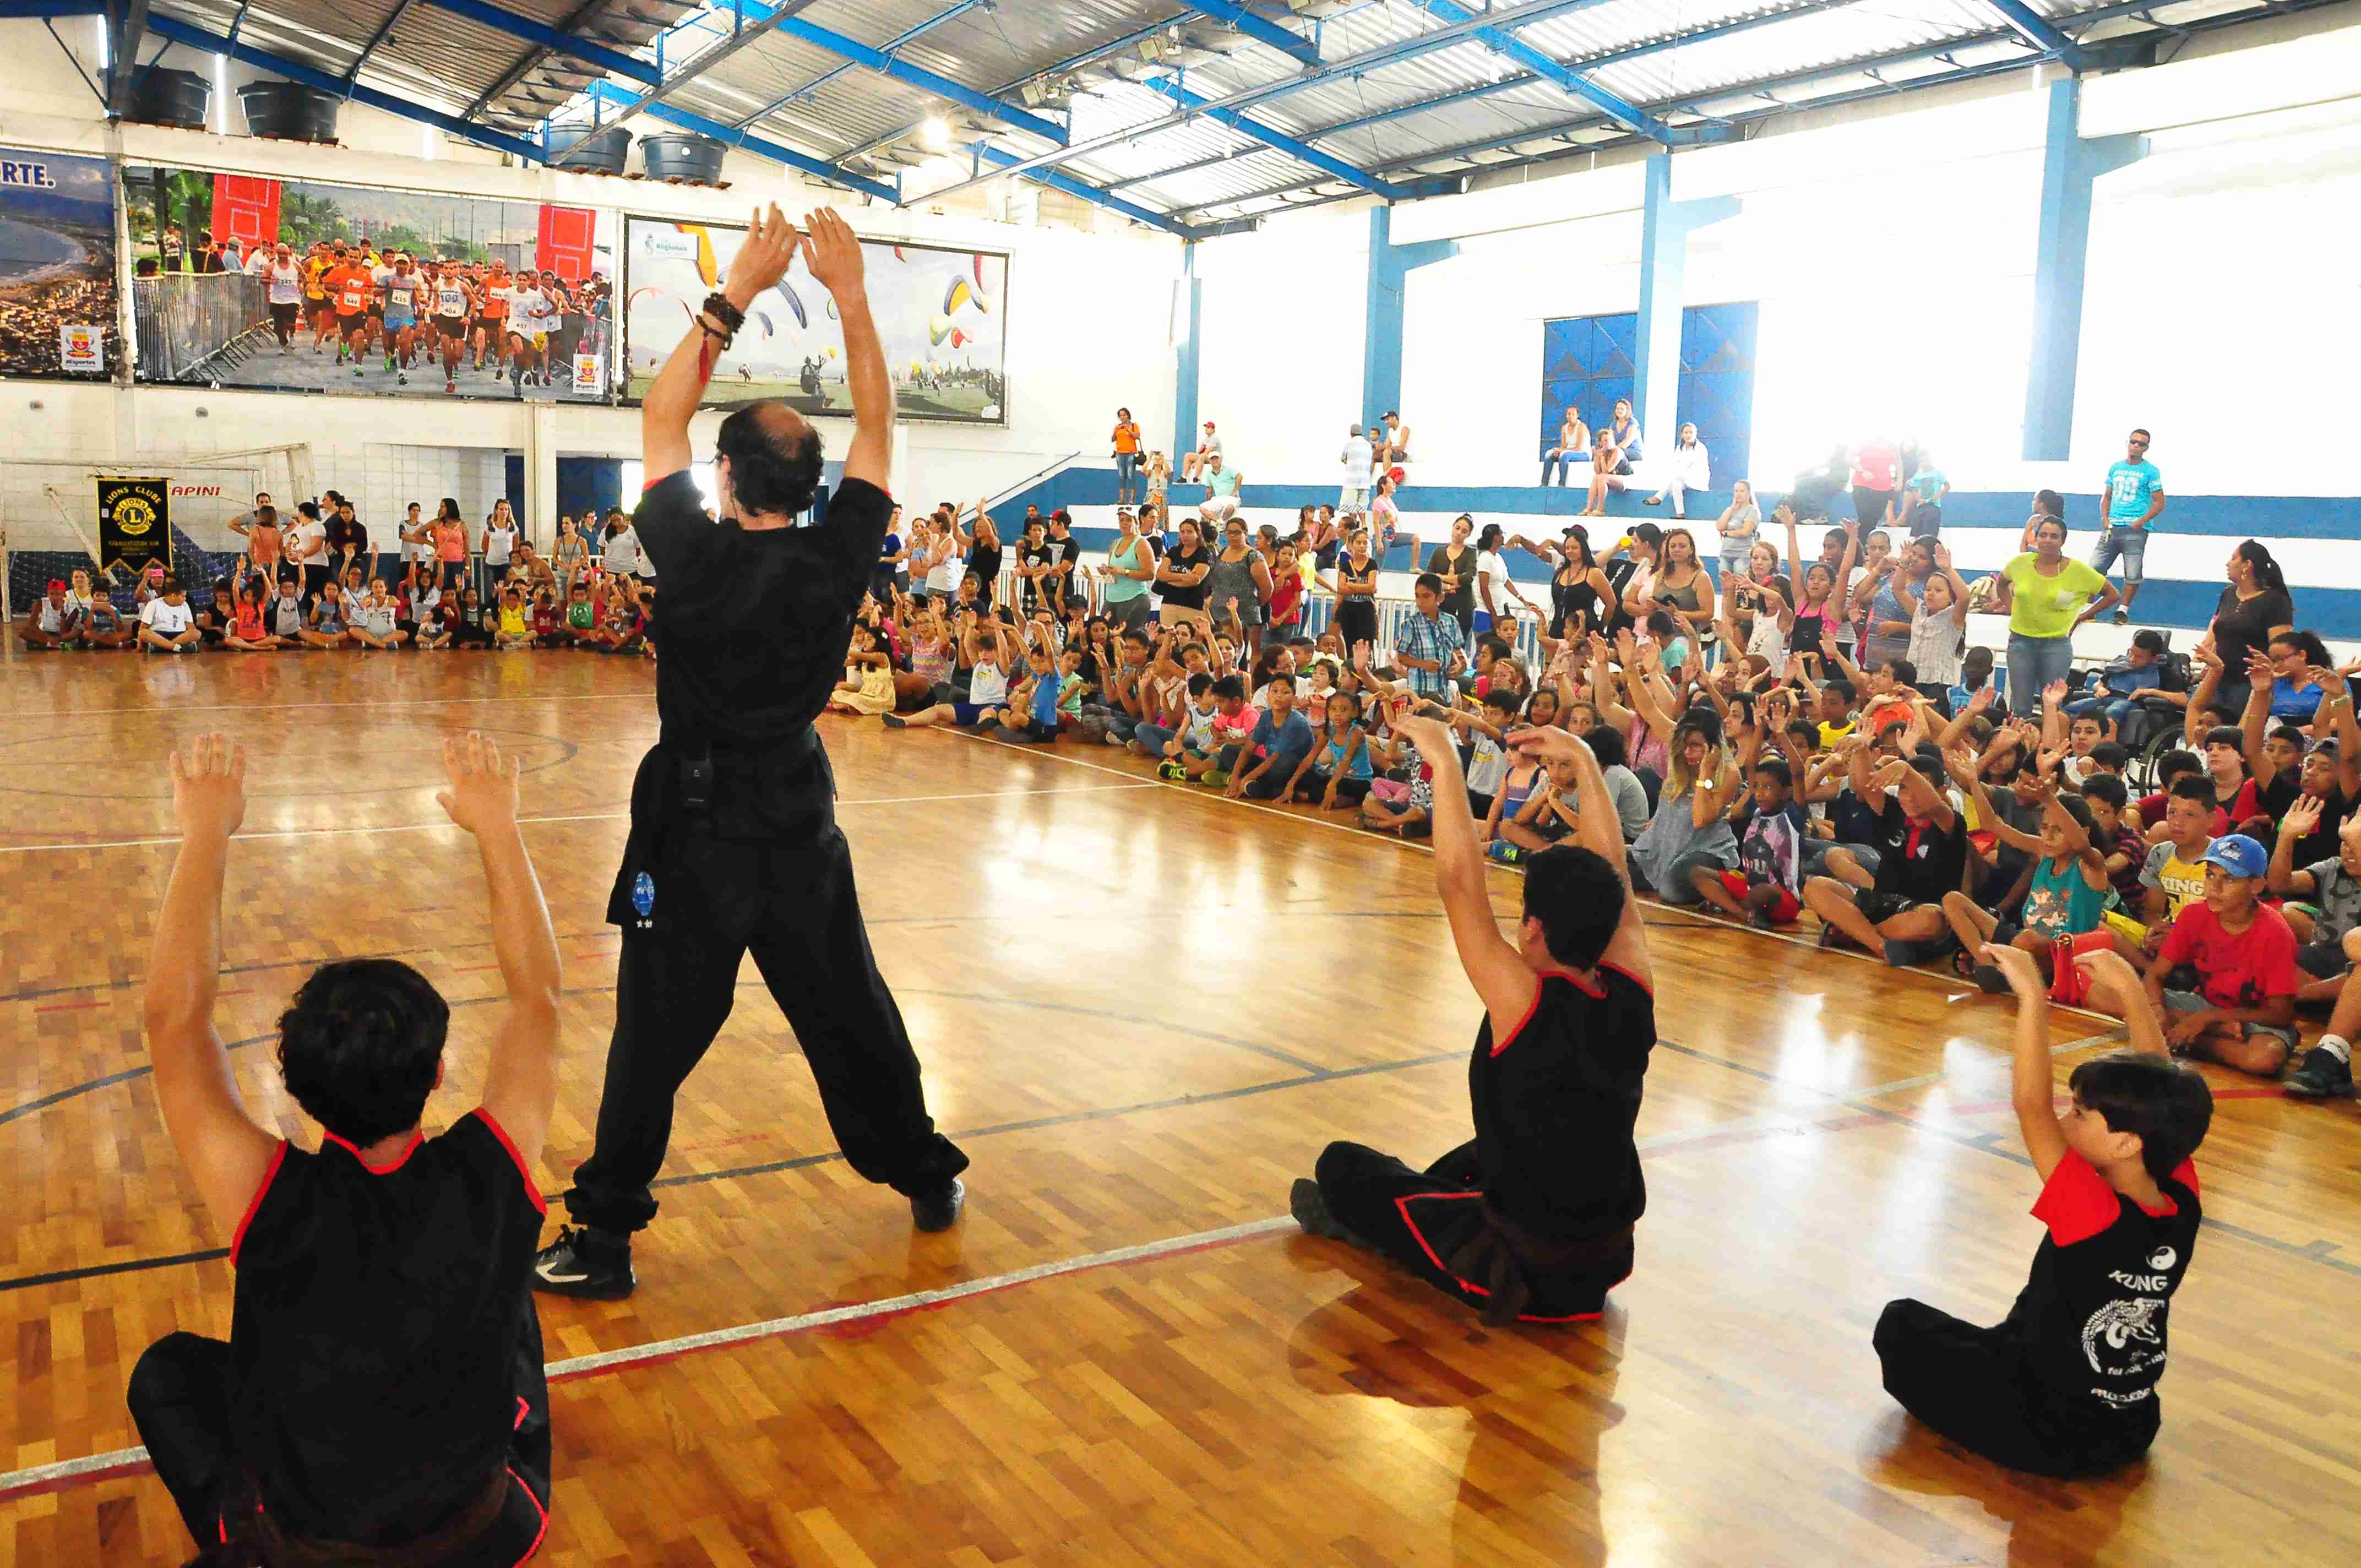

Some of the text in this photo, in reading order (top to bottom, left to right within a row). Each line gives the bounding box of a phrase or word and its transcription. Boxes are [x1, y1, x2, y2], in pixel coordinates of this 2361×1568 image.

[105, 485, 162, 504] LIONS CLUBE
[2108, 1270, 2168, 1292] KUNG
